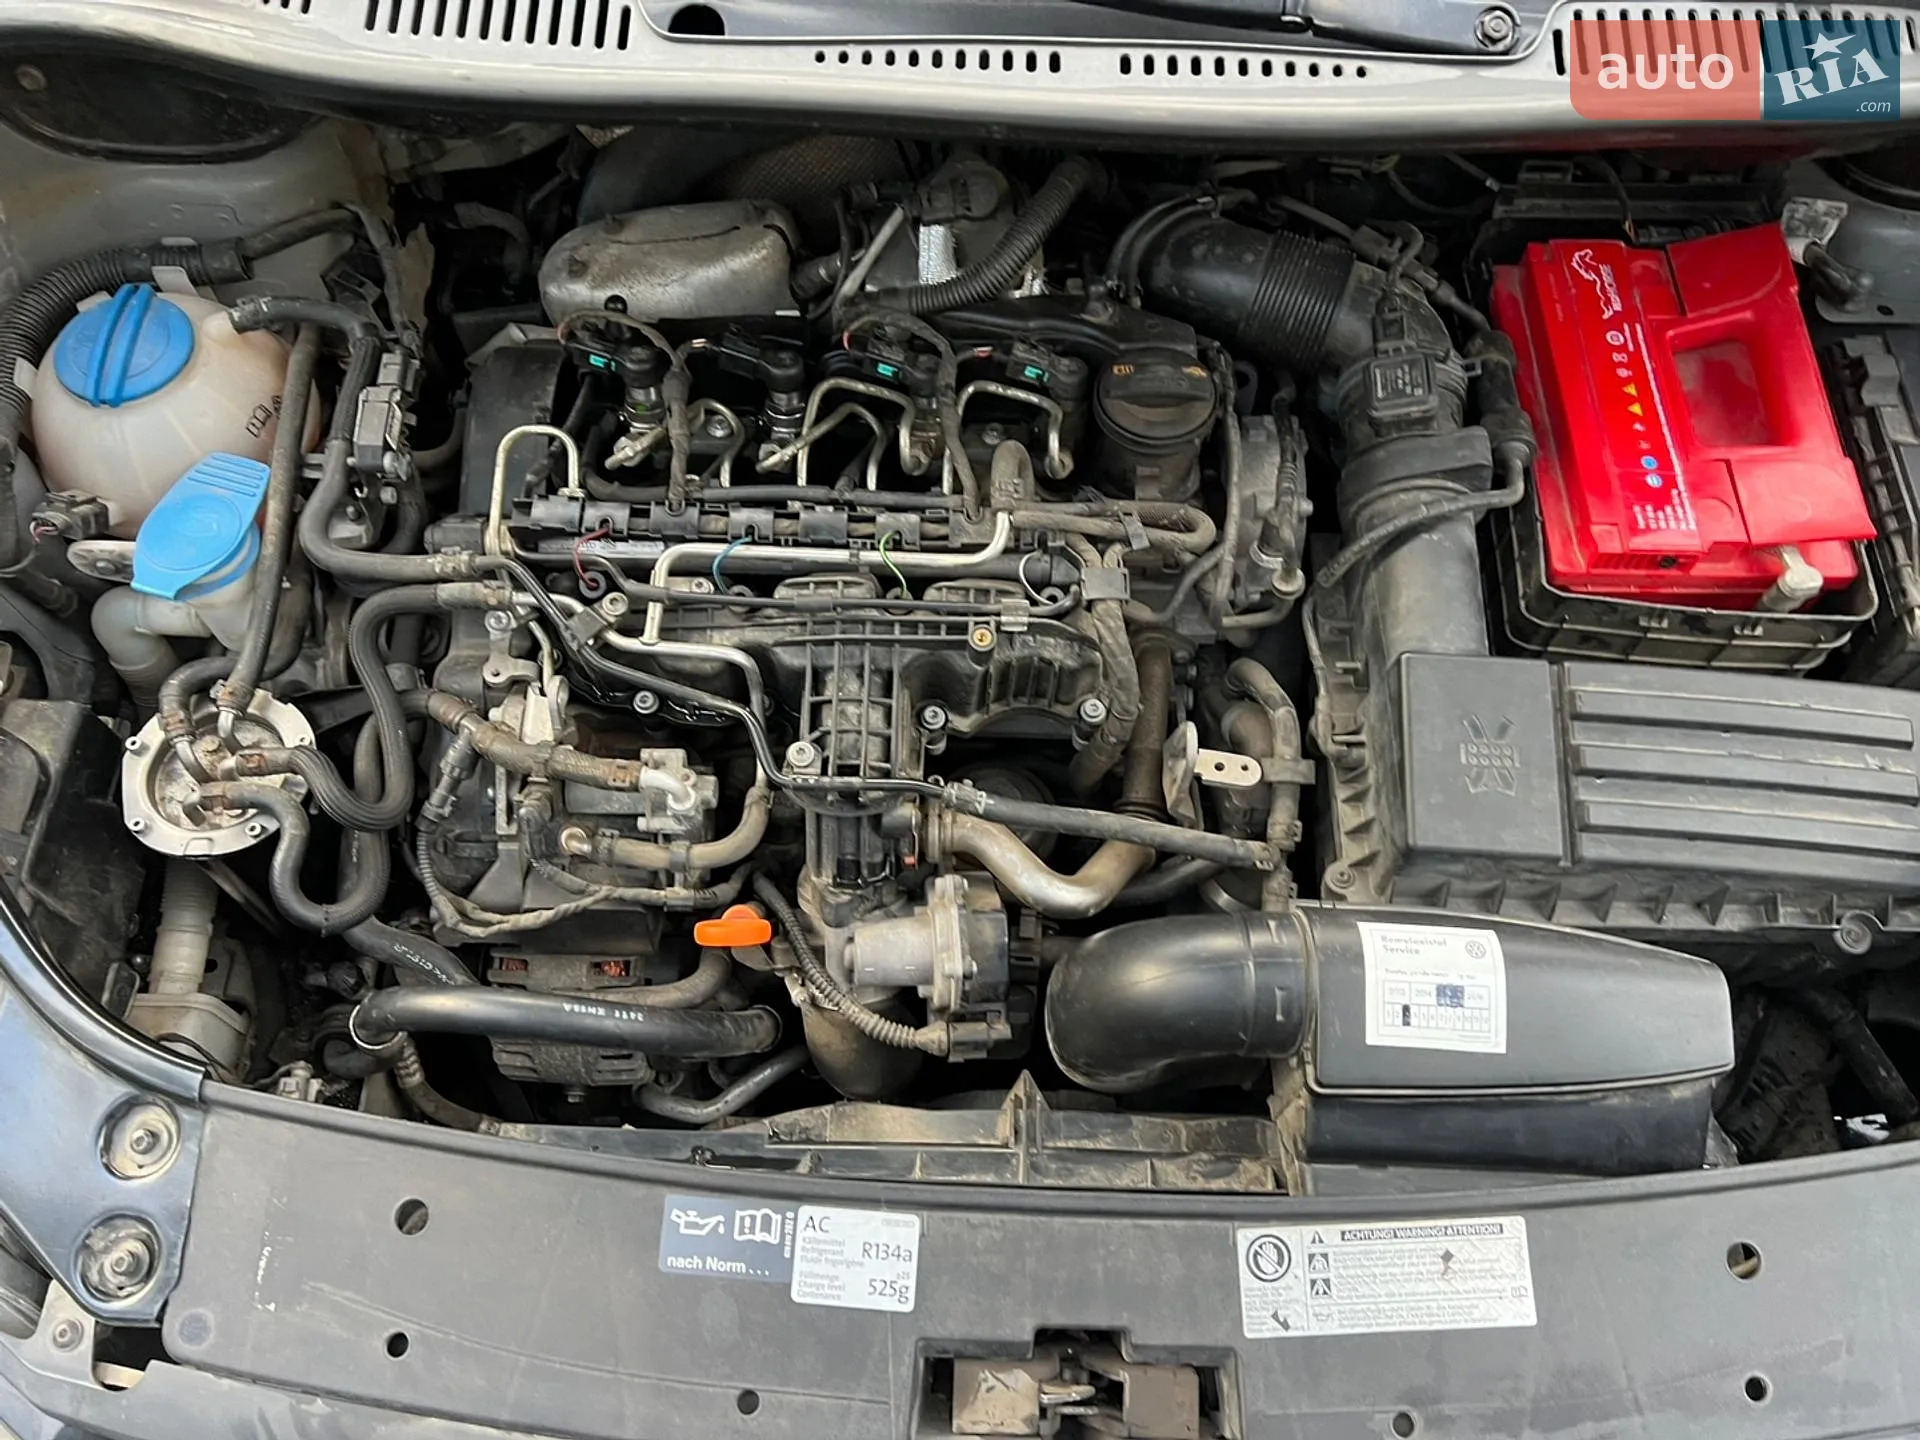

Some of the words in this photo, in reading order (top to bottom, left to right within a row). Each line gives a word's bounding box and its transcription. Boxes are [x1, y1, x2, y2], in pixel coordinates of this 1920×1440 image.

[803, 1215, 831, 1234] AC
[1344, 1229, 1394, 1241] ACHTUNG!
[1395, 1227, 1445, 1239] WARNING!
[1446, 1224, 1500, 1237] ATTENTION!
[861, 1241, 913, 1263] R134a
[667, 1255, 703, 1270] nach
[868, 1278, 910, 1304] 525g
